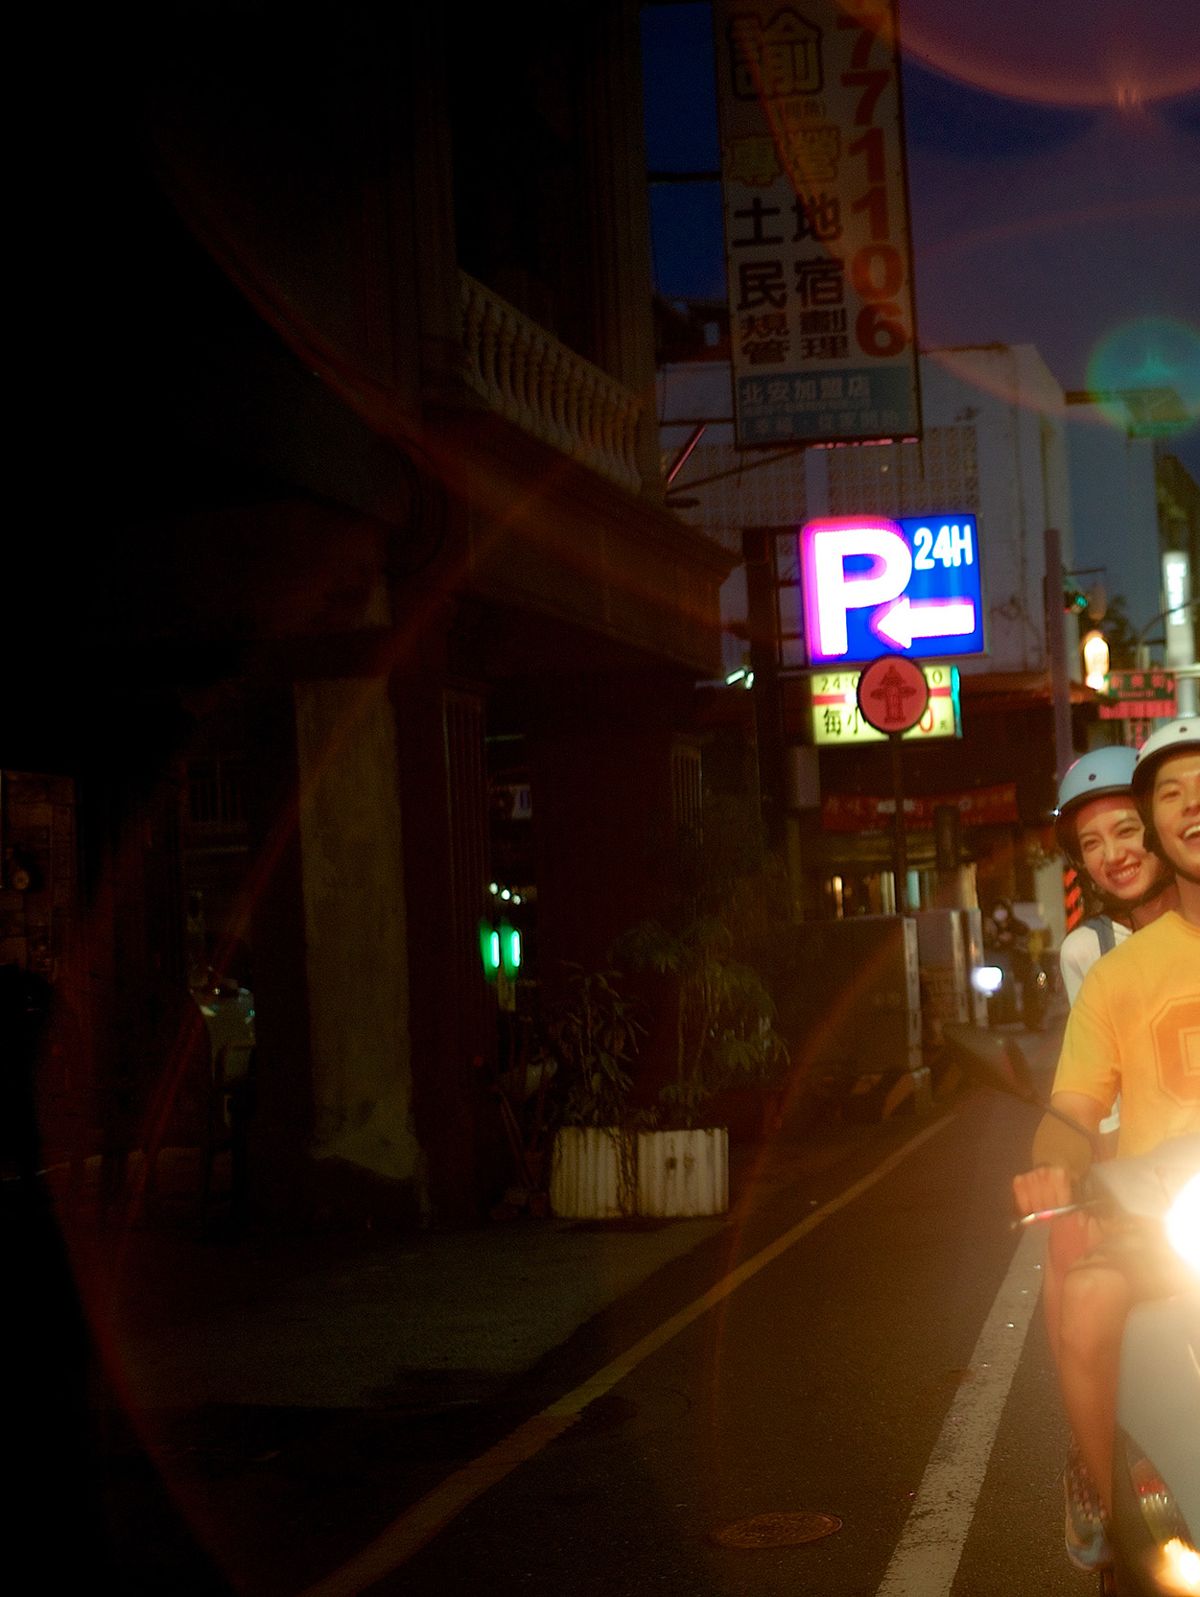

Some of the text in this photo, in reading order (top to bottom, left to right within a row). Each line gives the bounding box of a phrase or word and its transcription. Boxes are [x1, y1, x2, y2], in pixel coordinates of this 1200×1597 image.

[837, 0, 907, 357] 771106
[733, 193, 843, 247] 土地
[737, 256, 846, 310] 民宿
[913, 524, 973, 571] 24H
[814, 528, 912, 656] P
